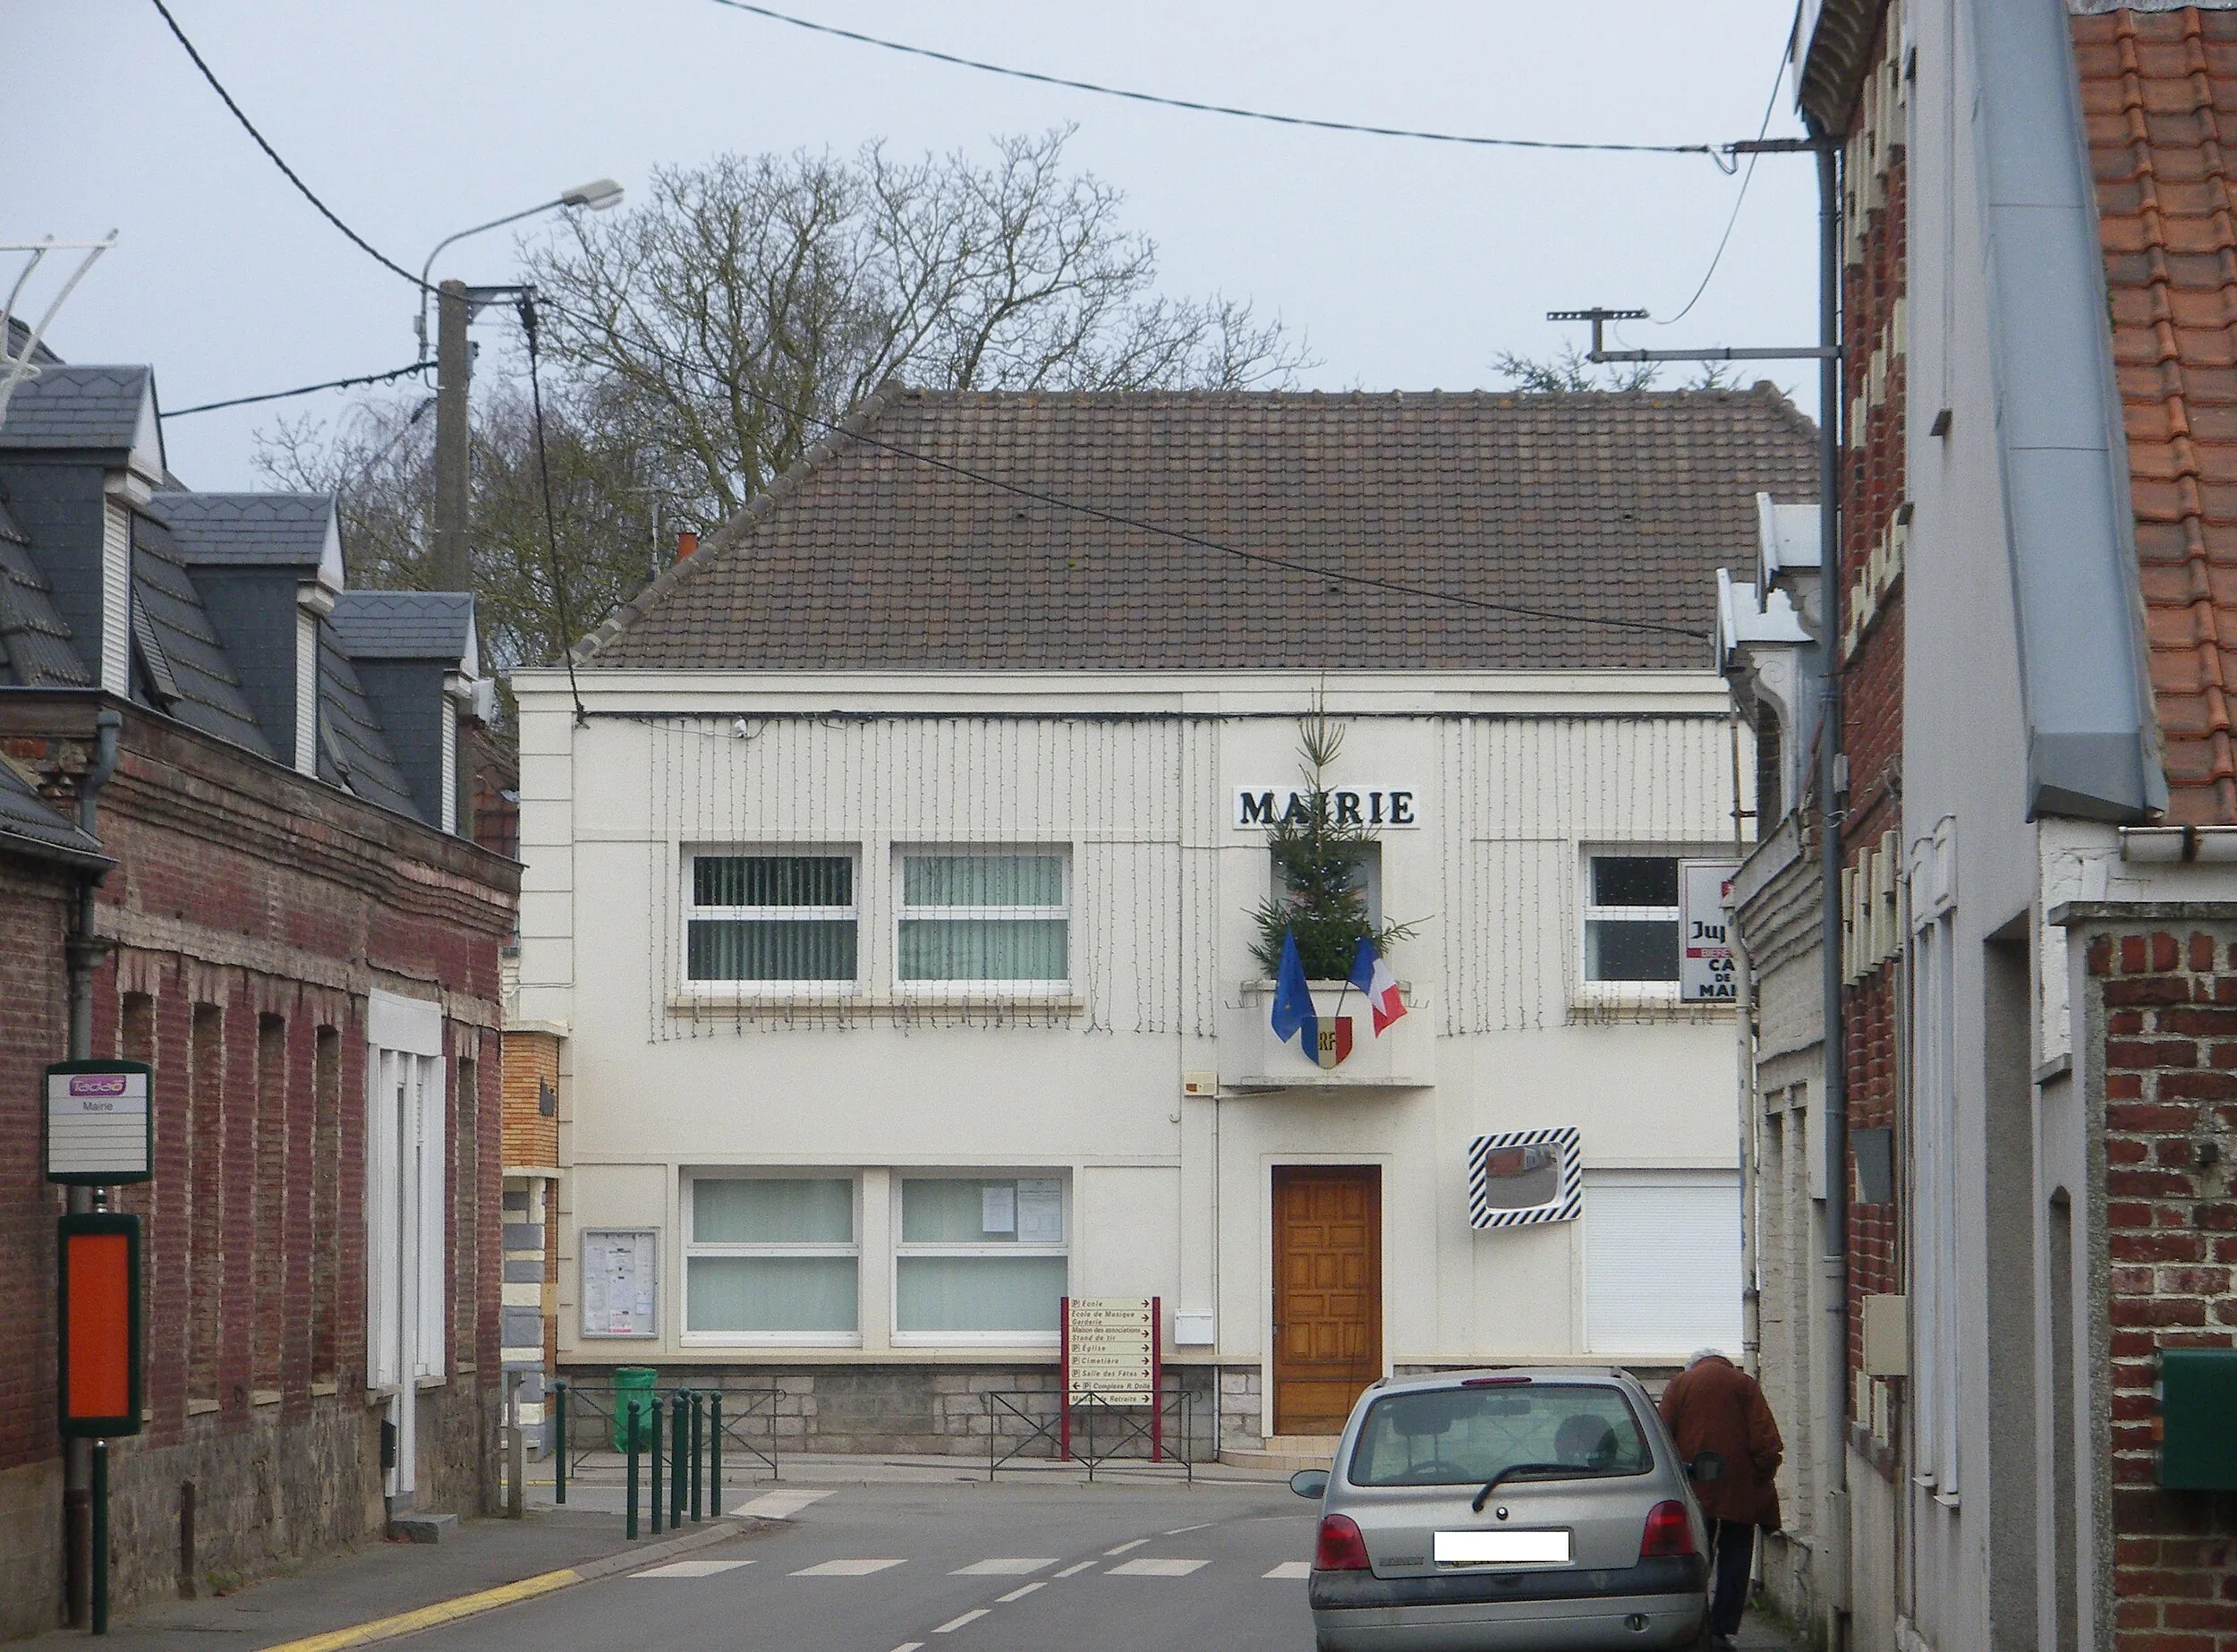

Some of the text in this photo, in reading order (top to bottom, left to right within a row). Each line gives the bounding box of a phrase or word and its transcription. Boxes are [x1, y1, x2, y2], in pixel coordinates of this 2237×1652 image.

[1240, 792, 1415, 824] MAIRIE
[1715, 974, 1731, 982] DE
[1319, 1032, 1336, 1051] RF
[83, 1102, 114, 1111] Mairie
[1105, 1310, 1135, 1318] Musique
[1093, 1383, 1125, 1391] Complexe
